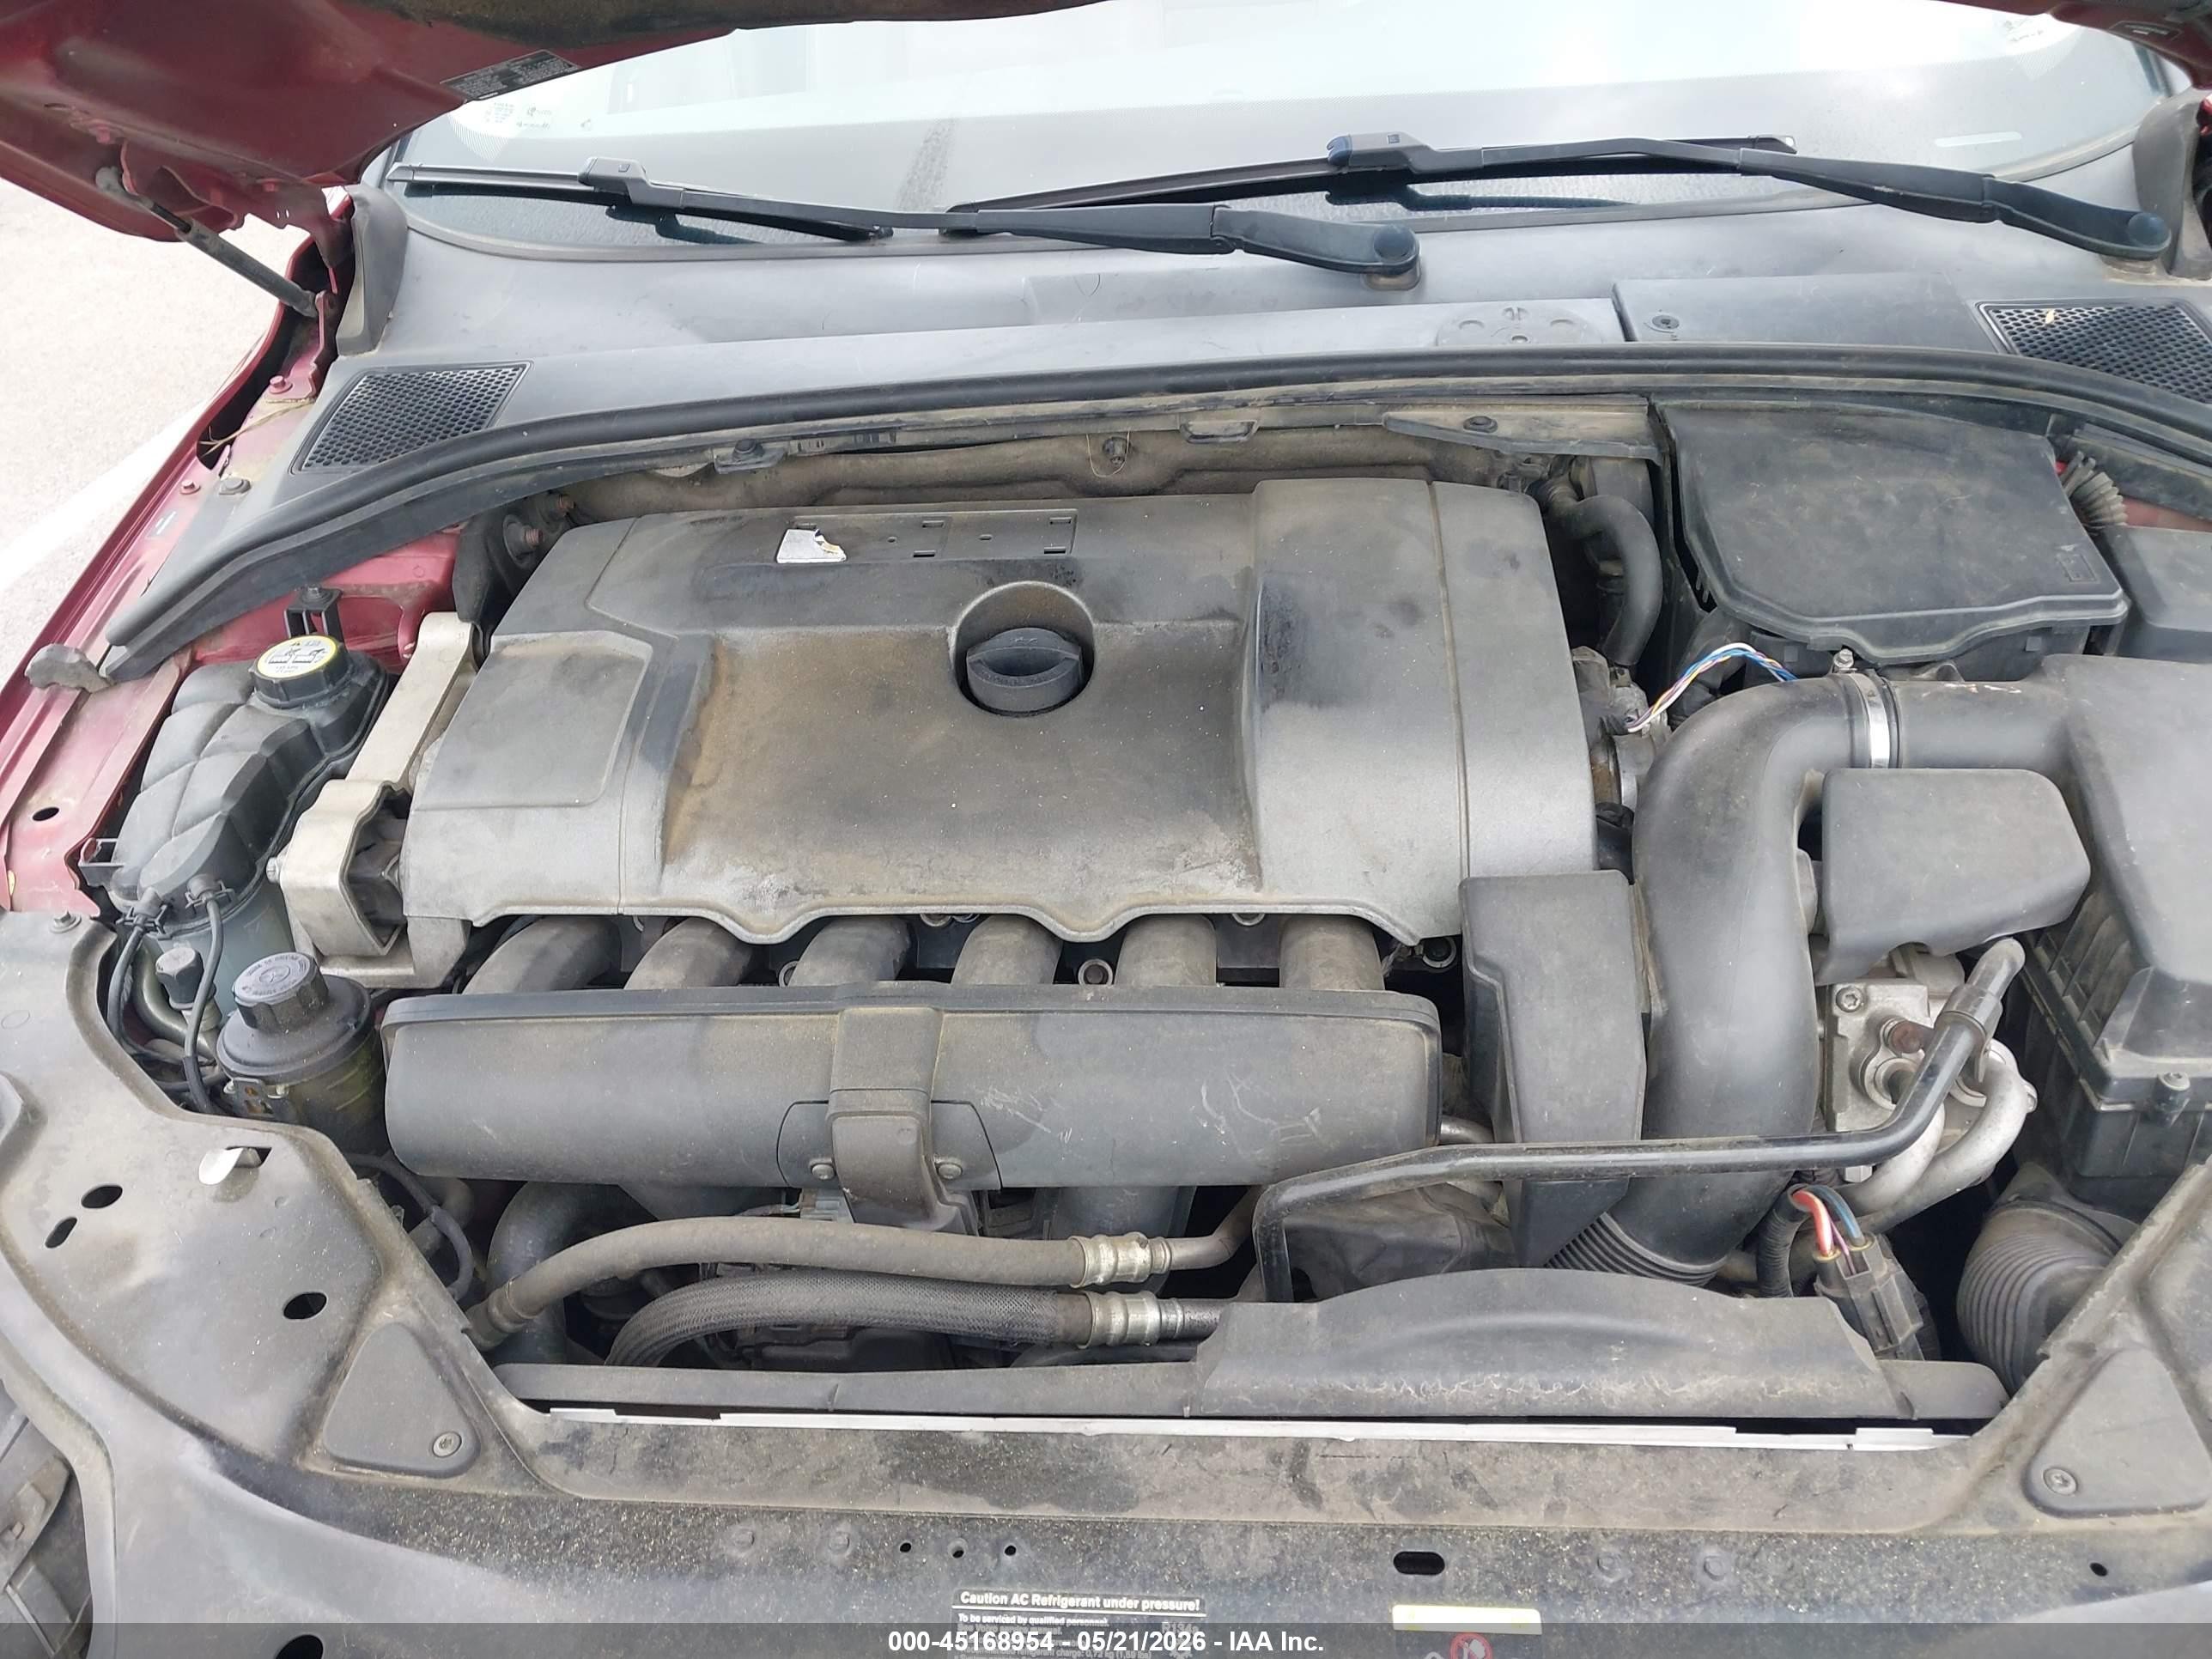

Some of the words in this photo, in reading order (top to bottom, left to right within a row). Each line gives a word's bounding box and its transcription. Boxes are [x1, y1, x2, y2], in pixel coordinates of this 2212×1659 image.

[960, 1591, 1009, 1605] Caution
[1011, 1593, 1029, 1606] AC
[1031, 1594, 1101, 1608] Refrigerant
[1103, 1597, 1139, 1609] under
[1141, 1599, 1200, 1612] pressure!
[958, 1613, 968, 1623] To
[969, 1613, 981, 1624] be
[981, 1614, 1016, 1625] serviced
[1017, 1615, 1028, 1626] by
[1029, 1616, 1066, 1627] qualified
